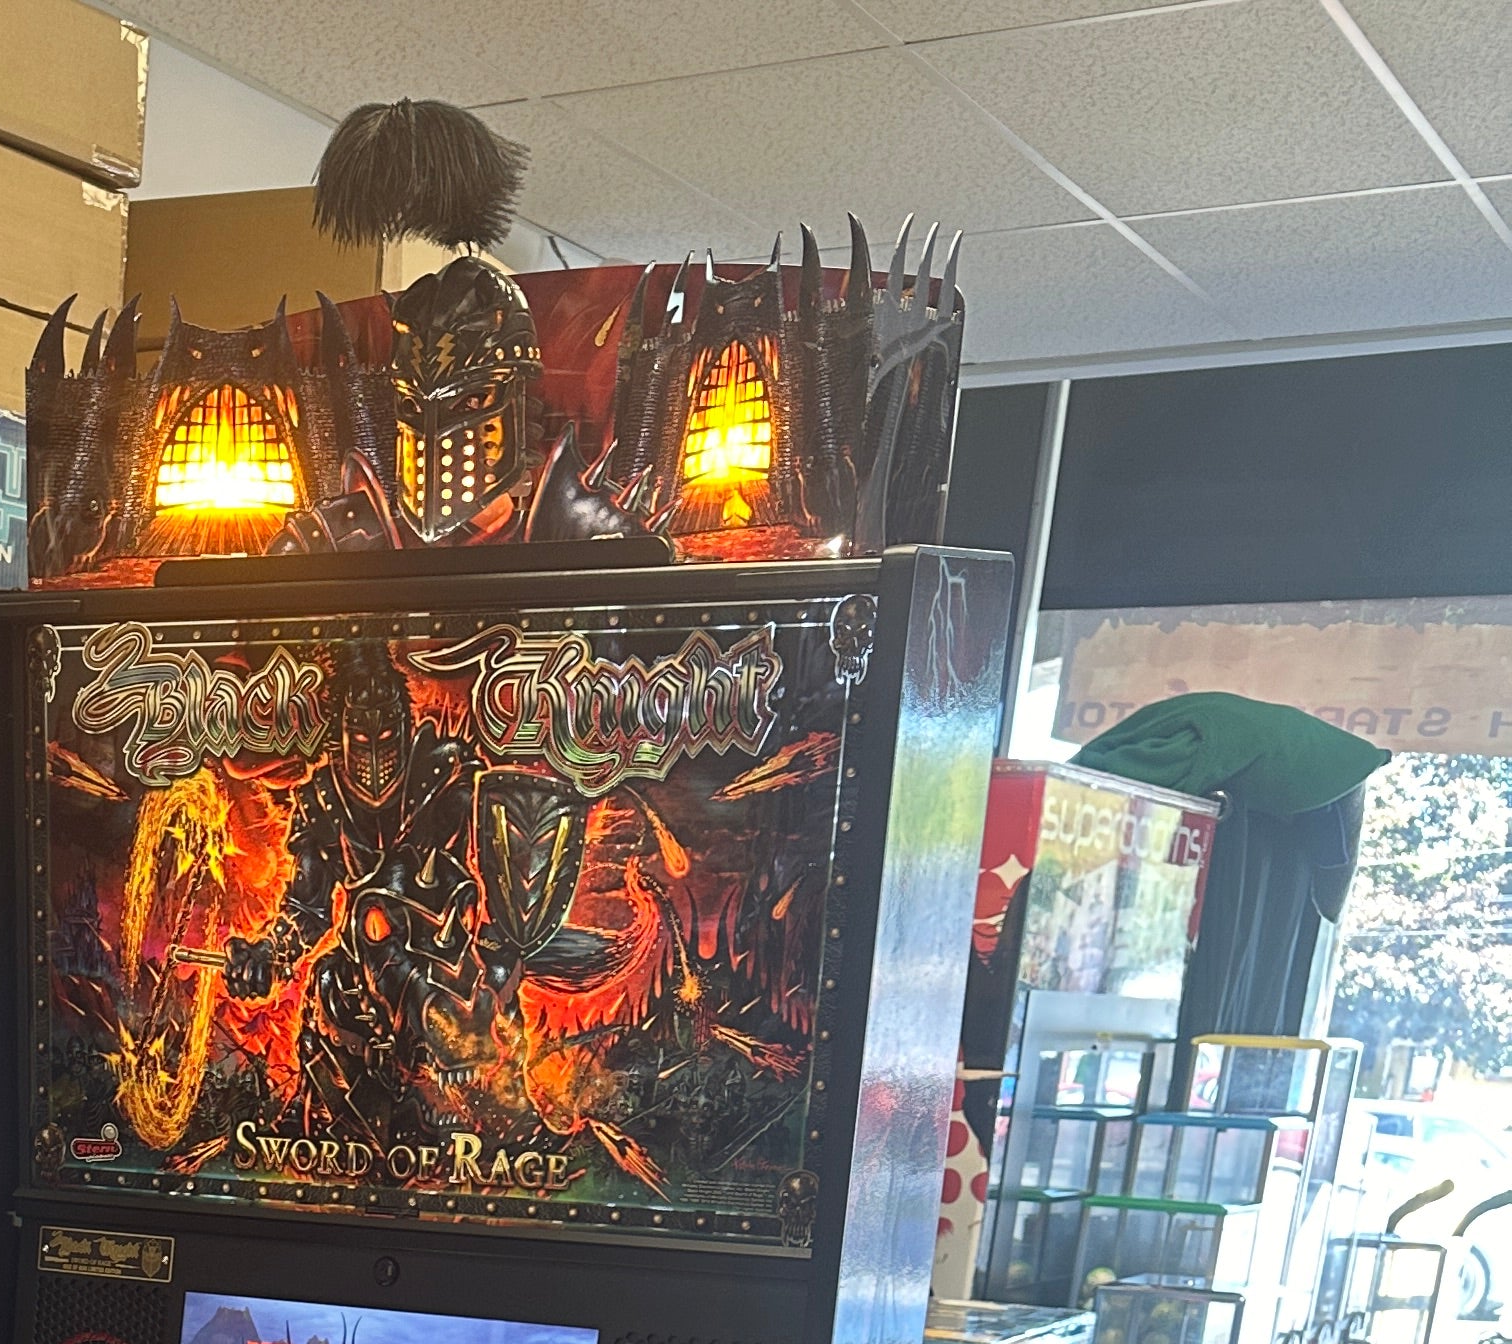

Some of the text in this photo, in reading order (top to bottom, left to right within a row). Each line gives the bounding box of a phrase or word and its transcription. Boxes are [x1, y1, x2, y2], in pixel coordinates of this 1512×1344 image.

[72, 621, 782, 797] Black Knight
[385, 1143, 439, 1179] OF
